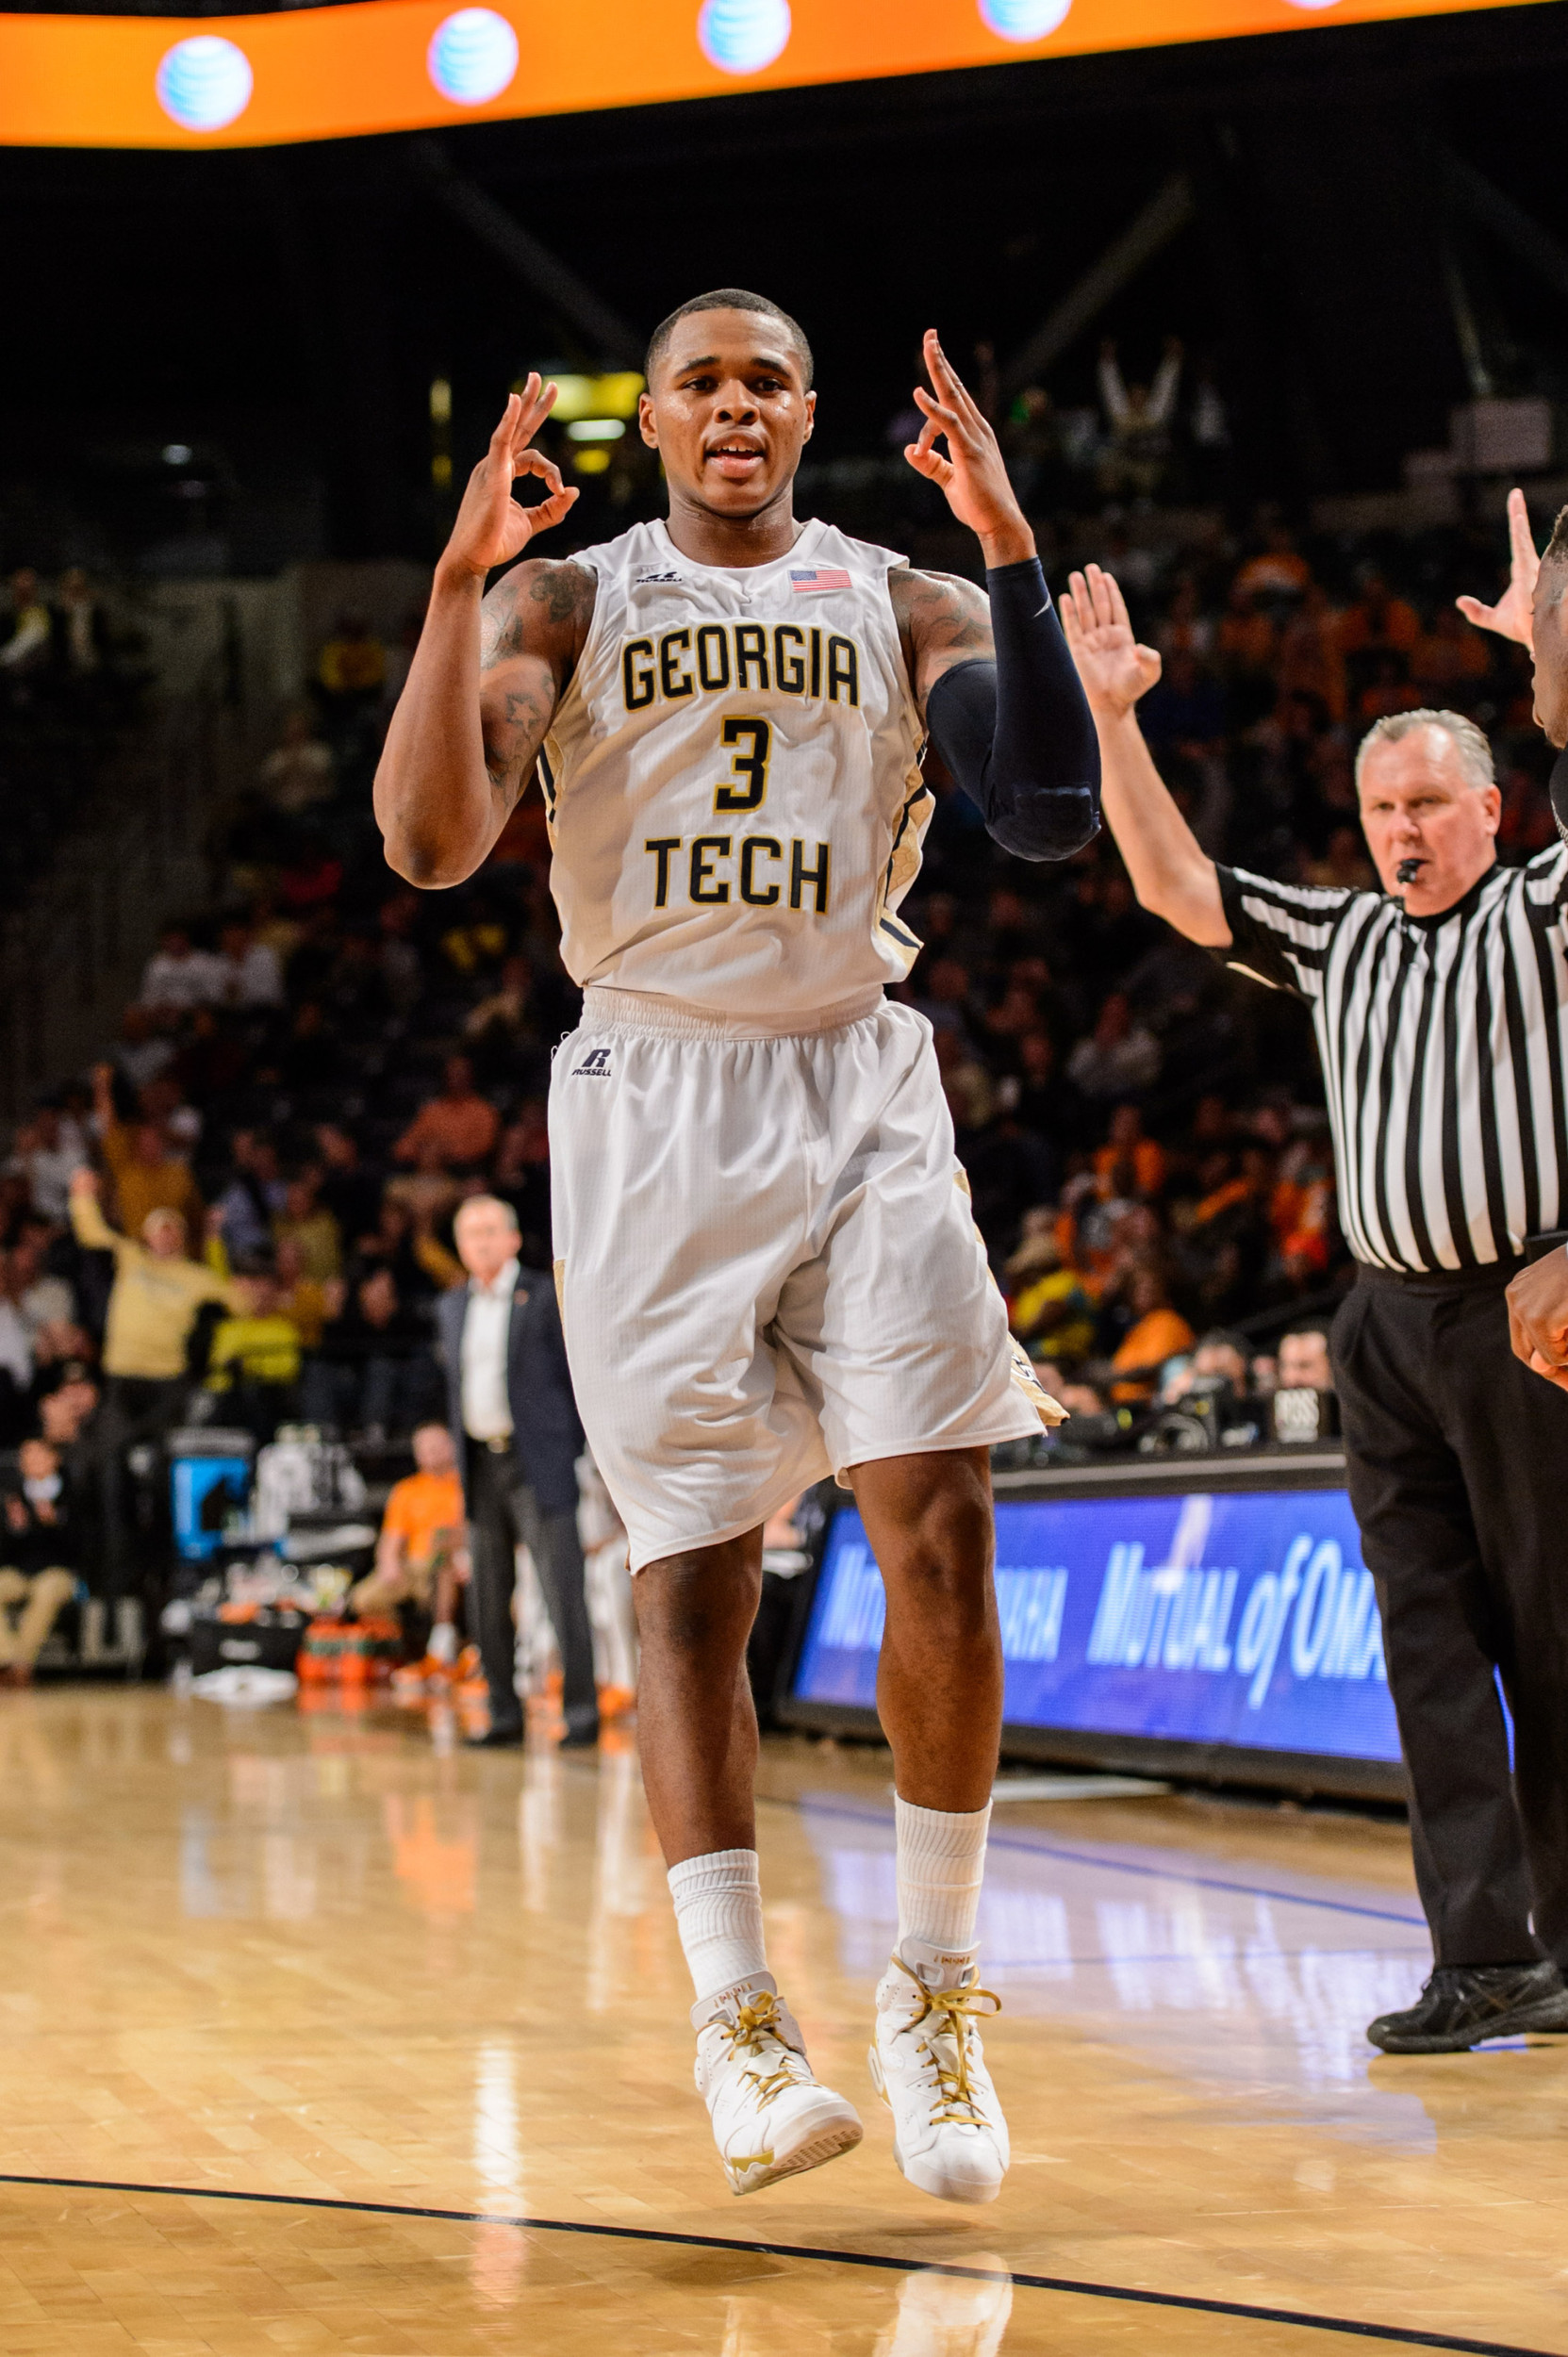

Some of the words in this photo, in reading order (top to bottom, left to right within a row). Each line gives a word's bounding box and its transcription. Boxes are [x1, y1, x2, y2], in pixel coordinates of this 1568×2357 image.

[621, 623, 860, 712] GEORGIA
[713, 715, 773, 815] 3
[645, 834, 830, 915] TECH
[571, 1068, 611, 1077] RUSSELL
[1235, 1532, 1313, 1709] of
